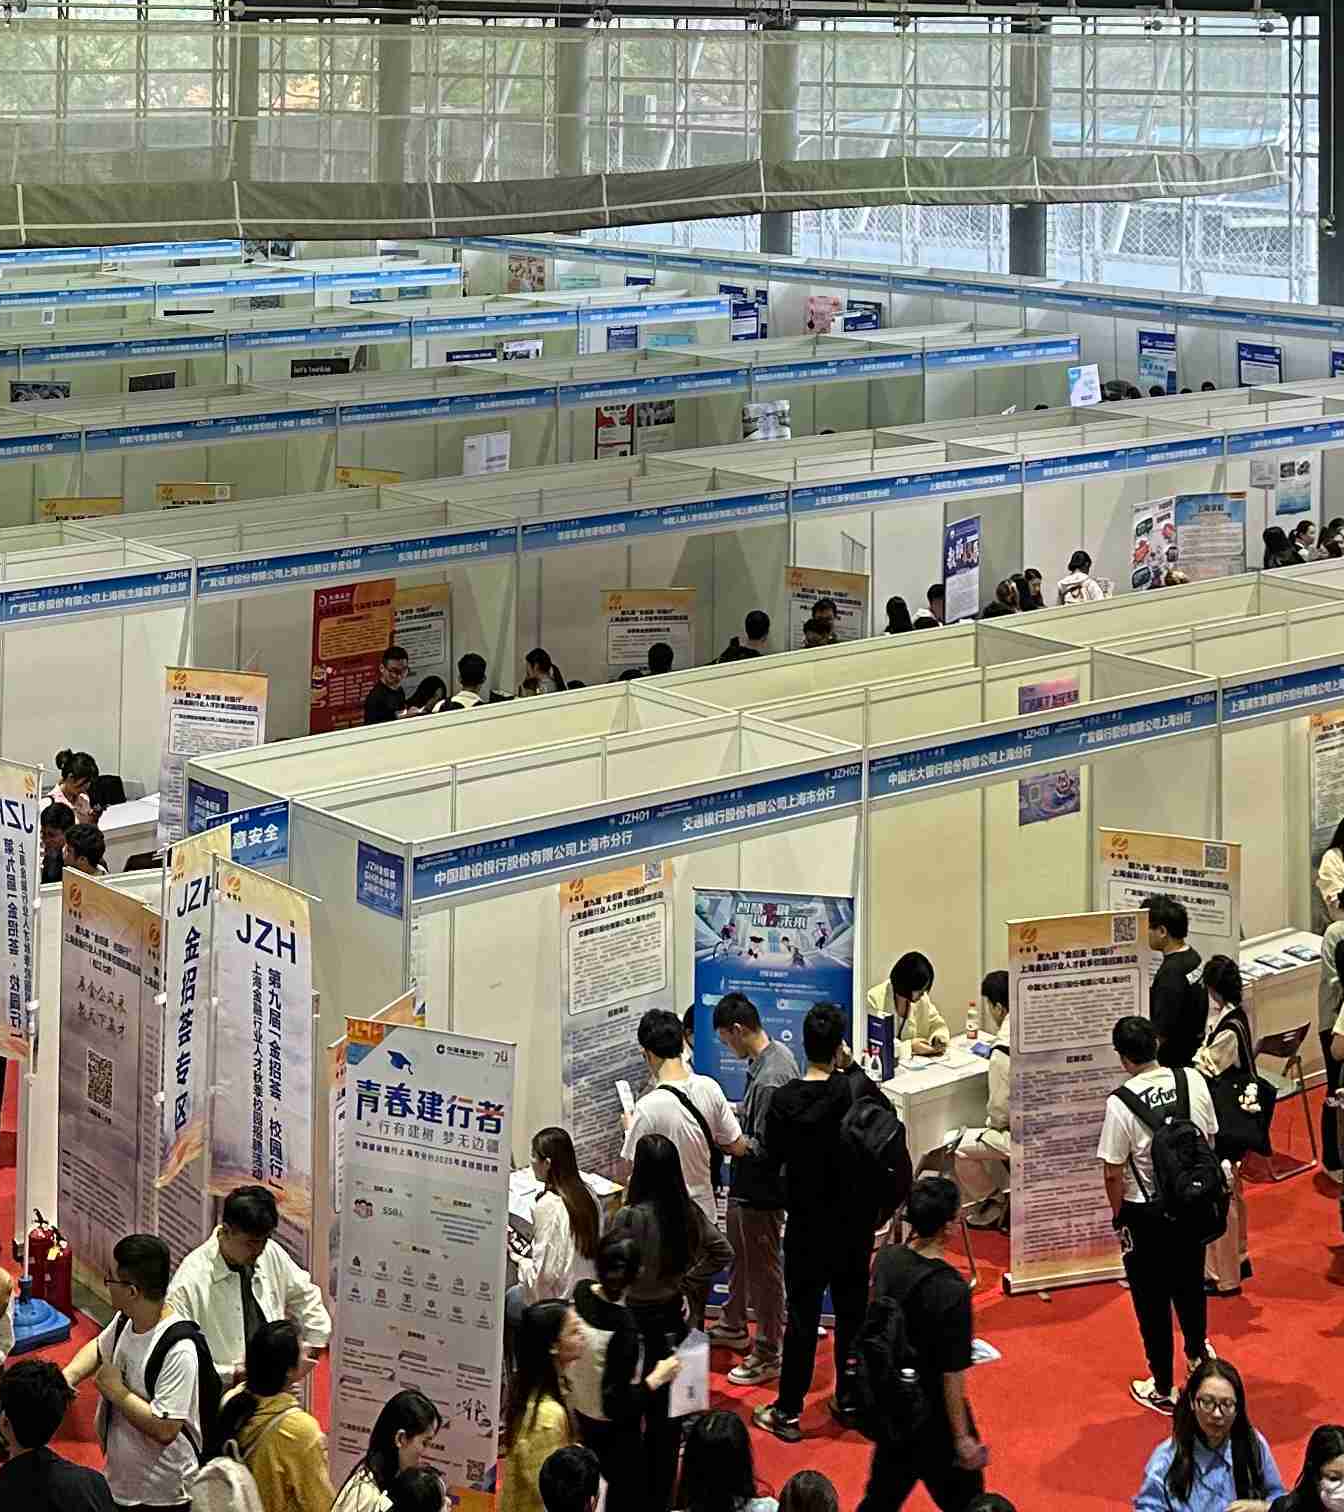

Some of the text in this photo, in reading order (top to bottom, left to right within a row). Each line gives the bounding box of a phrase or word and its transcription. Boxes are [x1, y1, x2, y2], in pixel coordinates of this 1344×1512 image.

[831, 764, 860, 780] JZH02
[888, 748, 1033, 787] 中国光大银行股份有限公司上海分行
[618, 810, 649, 826] JZH01
[682, 788, 837, 833] 交通银行股份有限公司上海市分行
[232, 824, 280, 850] 意安全
[434, 830, 633, 886] 中国建设银行股份有限公司上海市分行
[236, 914, 297, 965] JZH
[173, 925, 202, 1131] 金招荟专区
[356, 1079, 505, 1135] 青春建行者
[378, 1120, 435, 1142] 行有建树
